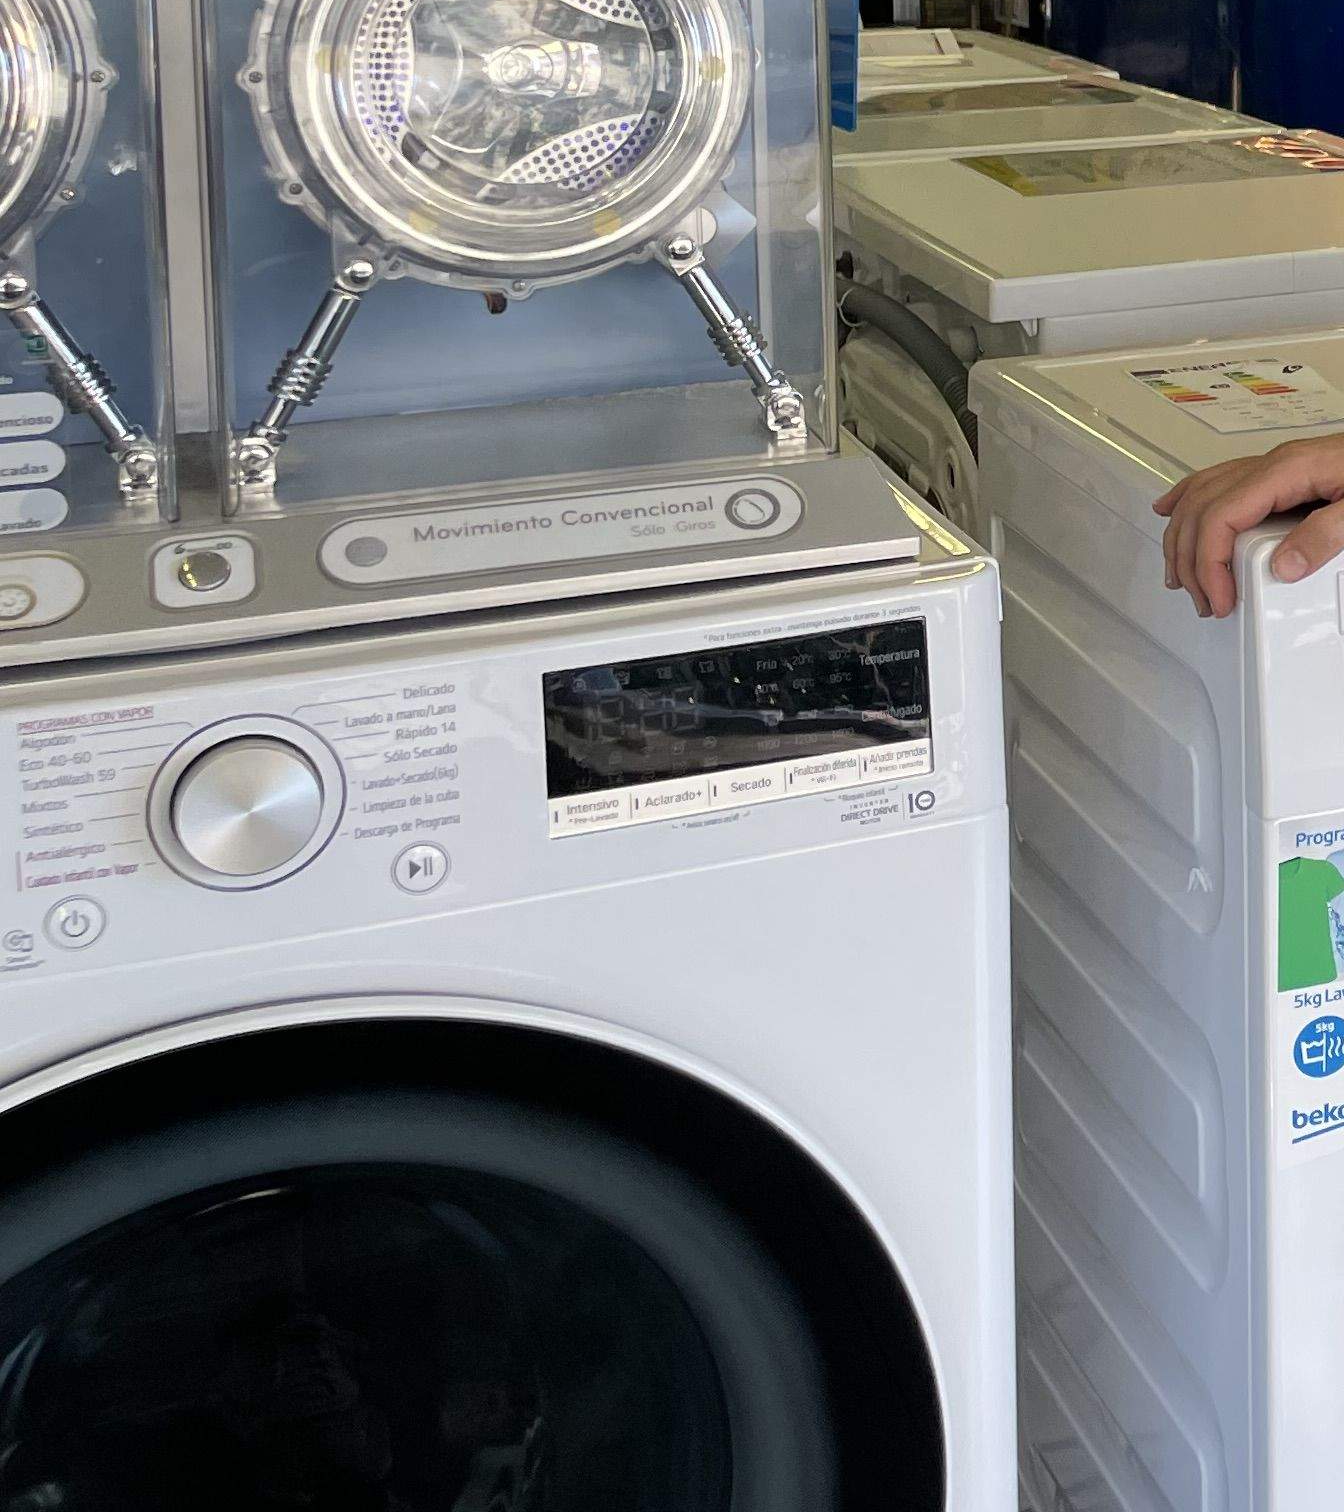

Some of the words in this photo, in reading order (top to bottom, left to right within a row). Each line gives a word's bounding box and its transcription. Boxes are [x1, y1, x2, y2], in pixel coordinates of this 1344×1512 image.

[413, 516, 552, 543] Movimiento
[561, 496, 714, 526] Convencional
[631, 522, 665, 538] Sólo
[859, 649, 920, 666] Temperatura
[403, 683, 455, 699] Delicado
[345, 713, 383, 728] Lavado
[387, 714, 393, 722] a
[396, 727, 437, 742] Rápido
[442, 722, 456, 732] 14
[384, 750, 411, 763] Sólo
[414, 743, 457, 759] Secado
[363, 798, 406, 813] Limpieza
[410, 796, 422, 807] de
[425, 794, 433, 803] la
[566, 797, 619, 816] Intensivo
[645, 788, 703, 809] Aclarado+
[731, 776, 772, 794] Secado
[841, 809, 870, 822] DIRECT
[873, 805, 898, 816] DRIVE
[355, 825, 398, 839] Descarga
[401, 822, 413, 832] de
[416, 814, 461, 830] Programa
[1293, 993, 1322, 1010] 5kg
[1315, 1021, 1335, 1034] 5kg
